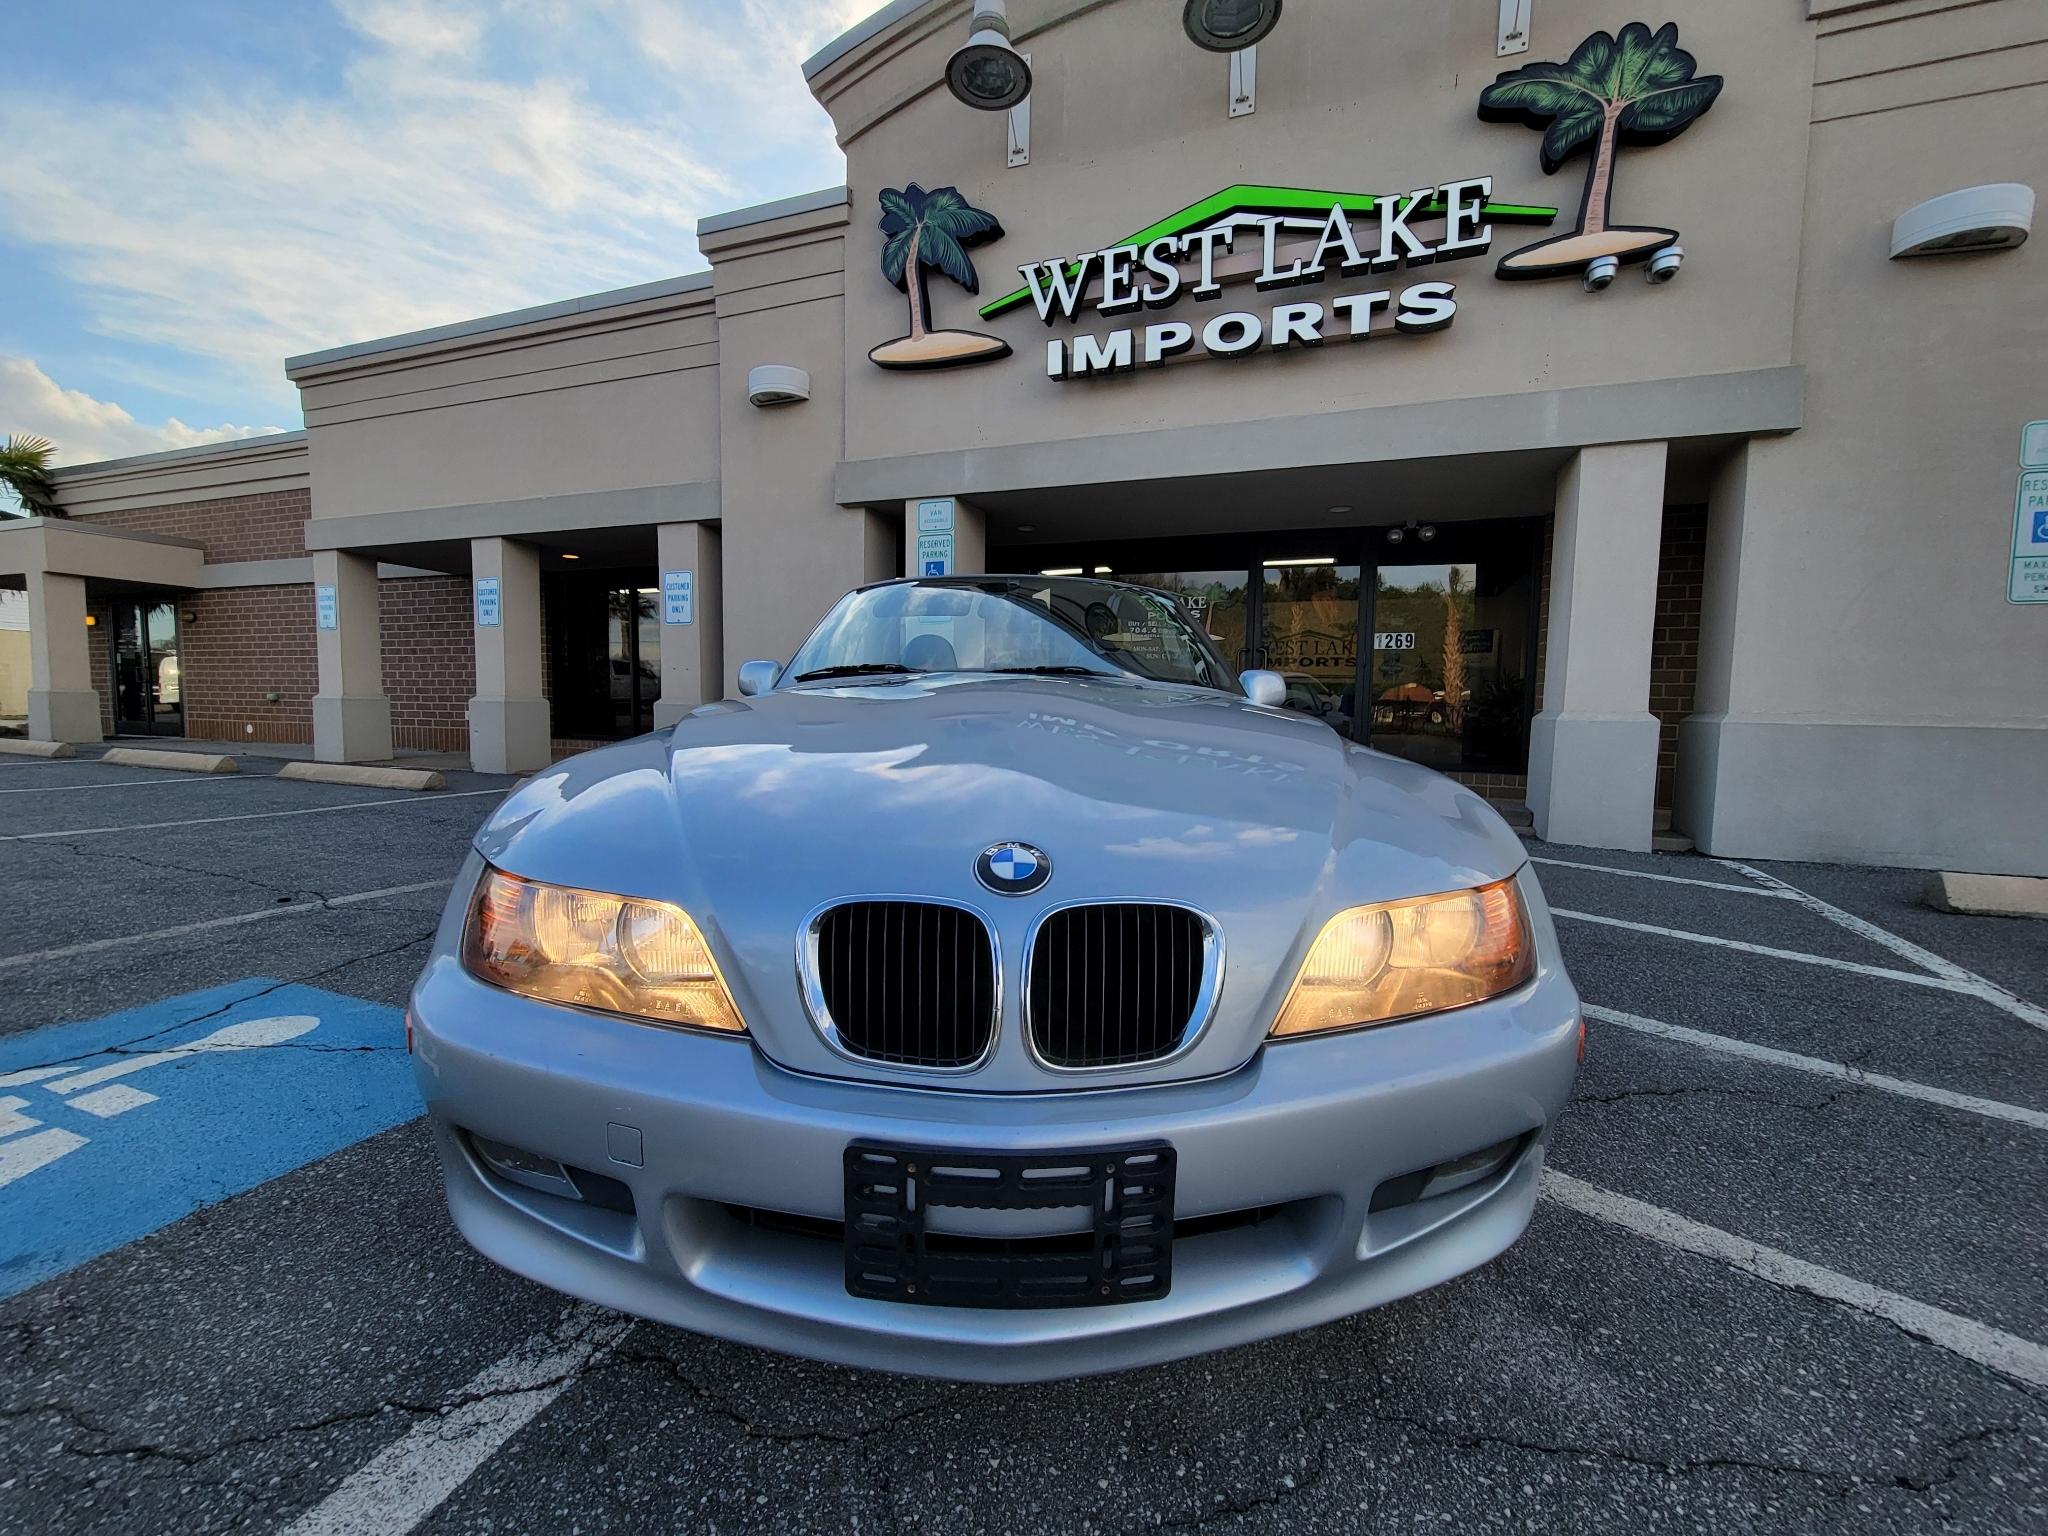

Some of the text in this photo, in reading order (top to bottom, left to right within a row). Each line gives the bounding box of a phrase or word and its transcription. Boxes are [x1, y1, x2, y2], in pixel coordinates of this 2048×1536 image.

[1018, 176, 1493, 321] WEST LAKE
[1047, 281, 1458, 377] IMPORTS
[920, 539, 950, 549] RESERVED
[922, 550, 948, 559] PARKING
[667, 583, 689, 591] CUSTOMER
[667, 594, 688, 602] PARKING
[671, 606, 684, 614] ONLY
[1375, 633, 1414, 649] 1269
[985, 843, 1044, 856] BMW
